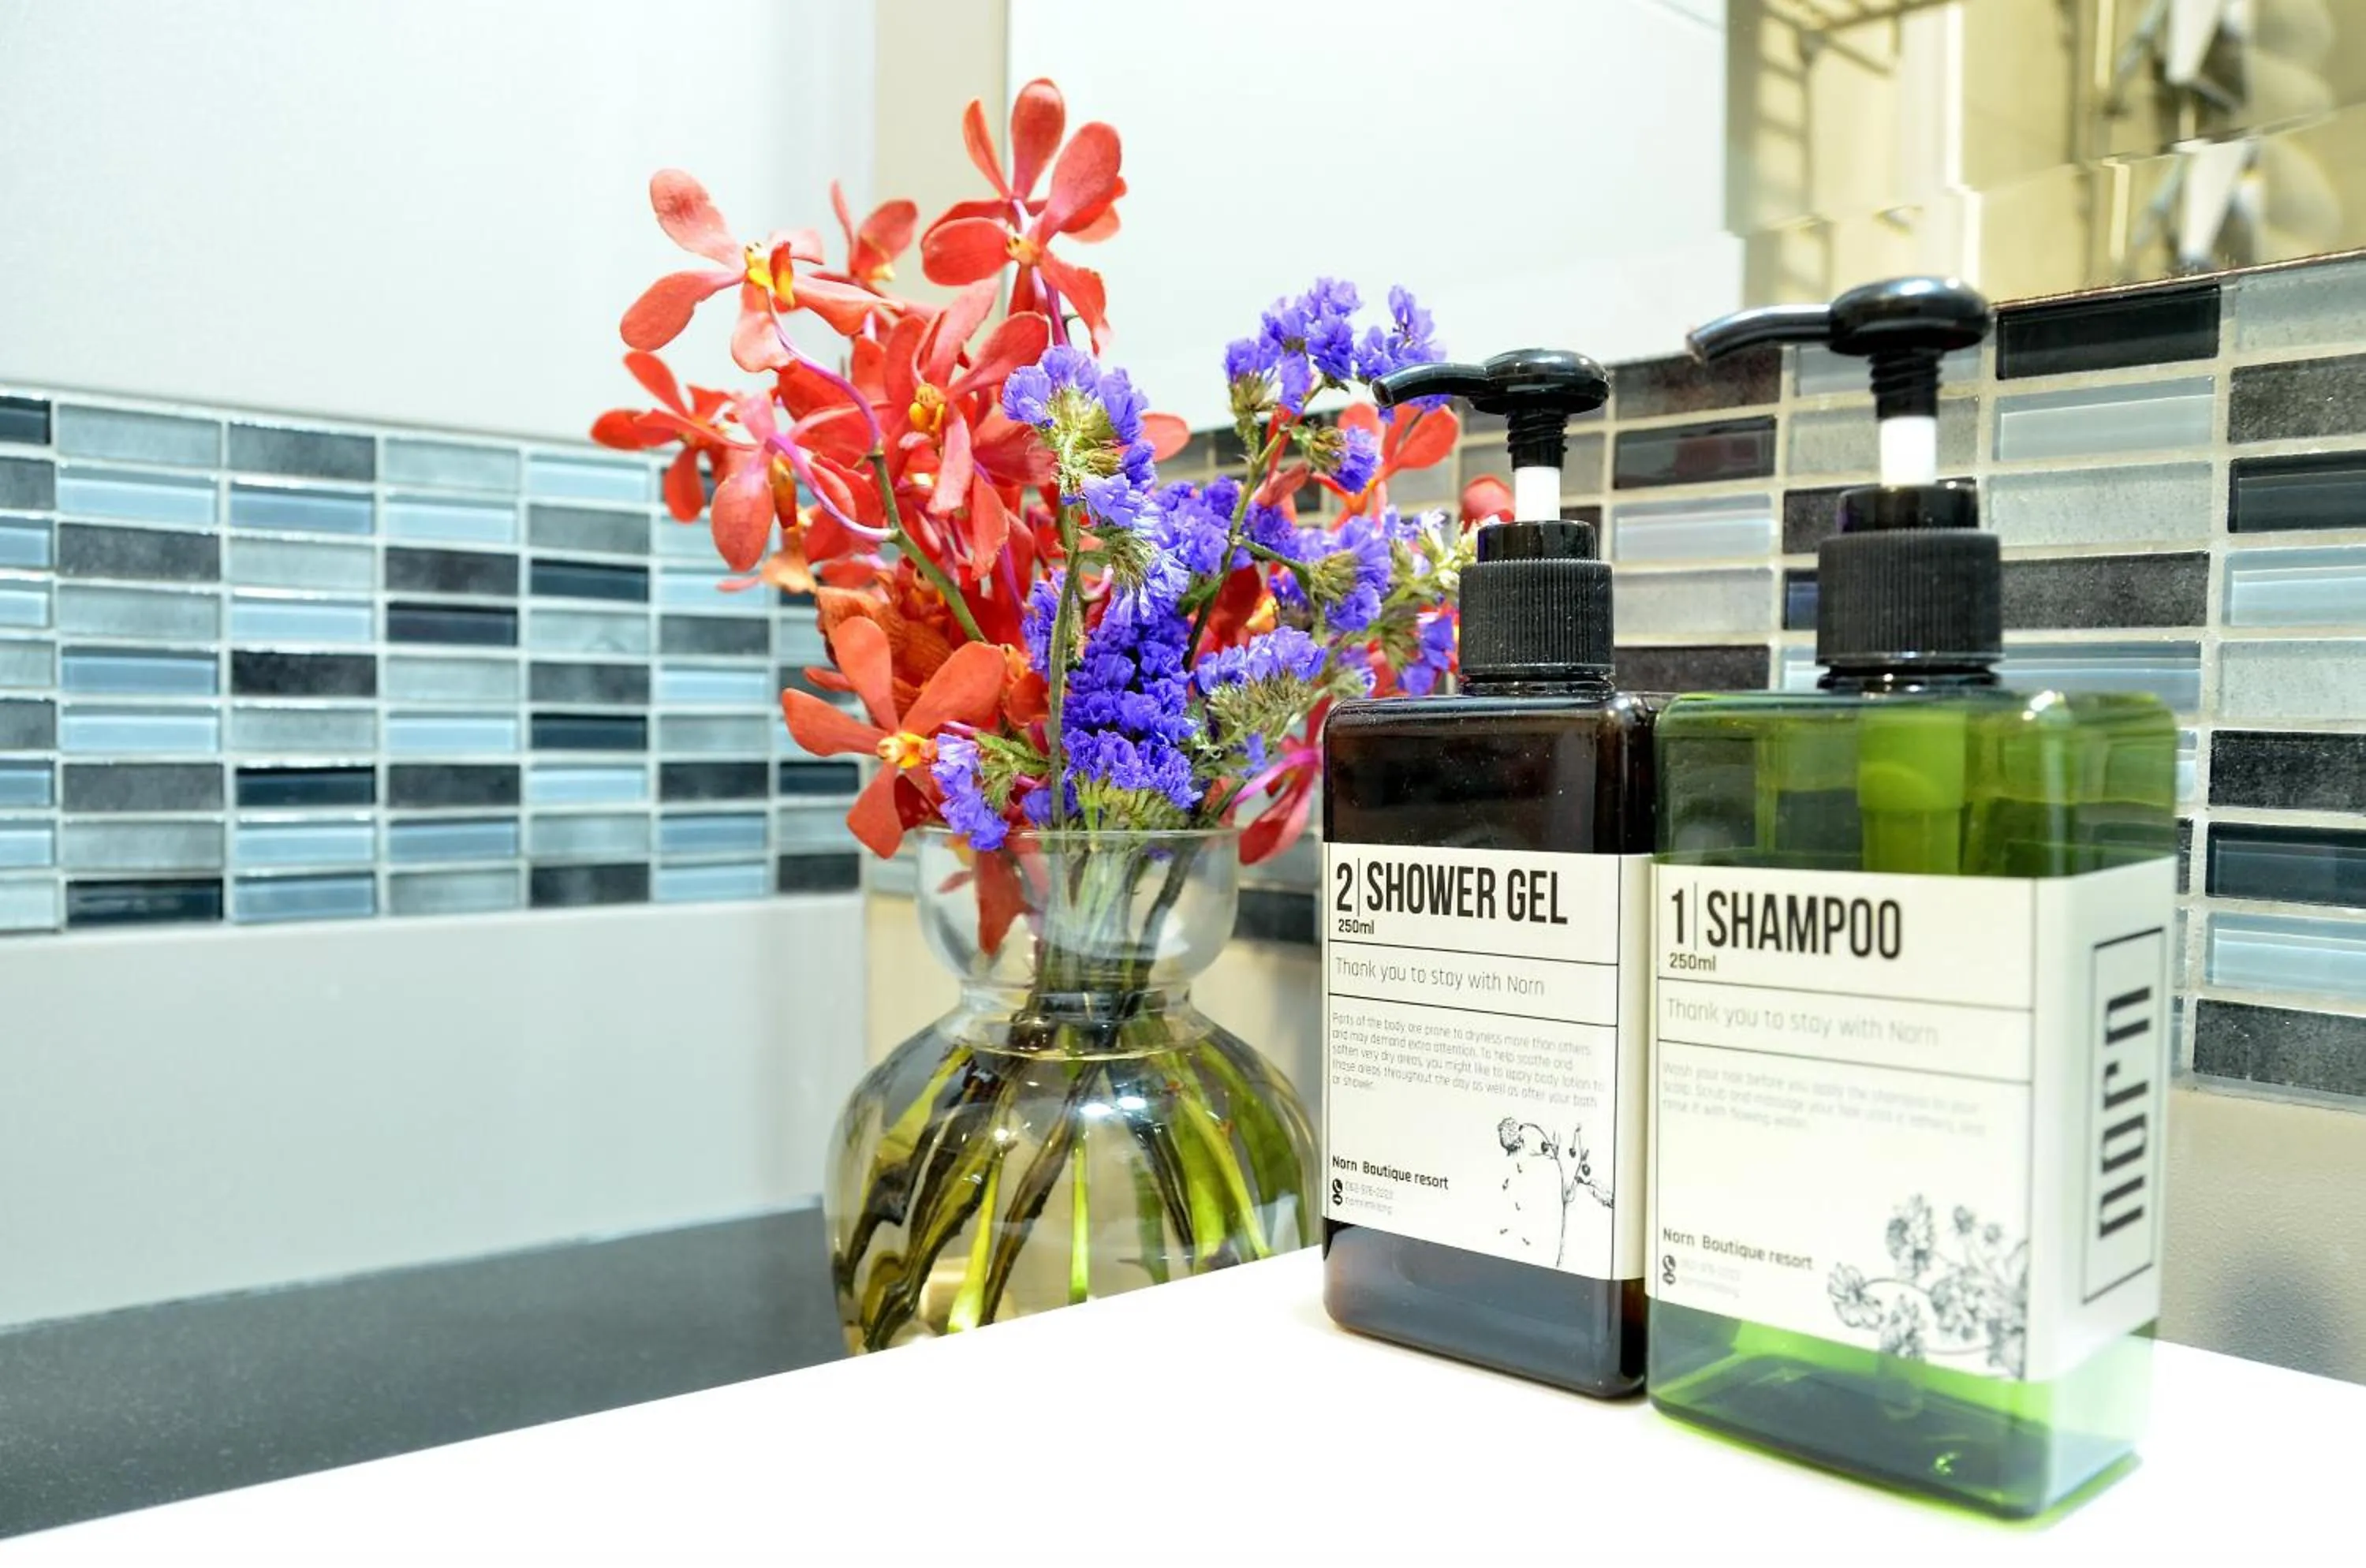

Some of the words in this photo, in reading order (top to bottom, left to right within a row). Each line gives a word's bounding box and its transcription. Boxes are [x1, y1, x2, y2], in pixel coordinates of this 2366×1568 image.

[1337, 862, 1353, 913] 2
[1367, 861, 1496, 919] SHOWER
[1507, 868, 1569, 924] GEL
[1338, 919, 1375, 935] 250ml
[1670, 887, 1685, 945] 1
[1706, 889, 1902, 960] SHAMPOO
[1335, 957, 1376, 980] Thank
[1381, 964, 1406, 984] you
[1411, 965, 1425, 984] to
[1431, 967, 1463, 991] stay
[1468, 972, 1502, 992] with
[1507, 975, 1545, 997] Norn
[1669, 953, 1717, 972] 250ml
[1356, 1015, 1365, 1025] of
[1367, 1017, 1382, 1029] the
[1384, 1018, 1405, 1033] body
[1409, 1024, 1422, 1032] are
[1425, 1025, 1450, 1036] prone
[1454, 1028, 1463, 1040] to
[1465, 1030, 1502, 1044] dryness
[1504, 1035, 1530, 1047] more
[1532, 1036, 1556, 1050] than
[1666, 998, 1719, 1021] Thank
[1723, 1006, 1760, 1027] you
[1764, 1010, 1786, 1032] to
[1790, 1012, 1831, 1040] stay
[1839, 1015, 1883, 1041] with
[1889, 1021, 1940, 1047] Norn
[1333, 1029, 1347, 1040] and
[1350, 1032, 1368, 1044] may
[1371, 1034, 1405, 1048] demand
[1409, 1040, 1431, 1051] extra
[1495, 1050, 1515, 1063] help
[1554, 1058, 1573, 1071] and
[1333, 1043, 1359, 1057] soften
[1361, 1049, 1379, 1061] very
[1382, 1050, 1395, 1063] dry
[1427, 1058, 1442, 1069] you
[1474, 1061, 1490, 1077] like
[1493, 1066, 1503, 1077] to
[1535, 1072, 1559, 1088] body
[1333, 1075, 1340, 1085] or
[1358, 1064, 1381, 1077] areas
[1384, 1067, 1431, 1084] throughout
[1435, 1073, 1450, 1085] the
[1453, 1077, 1469, 1090] day
[1472, 1081, 1483, 1092] as
[1487, 1083, 1506, 1095] well
[1507, 1086, 1519, 1097] as
[1521, 1087, 1545, 1100] after
[1333, 1155, 1357, 1171] Norn
[1363, 1161, 1412, 1182] Boutique
[1415, 1173, 1449, 1190] resort
[1663, 1226, 1695, 1247] Norn
[1702, 1234, 1766, 1262] Boutique
[1769, 1249, 1814, 1271] resort
